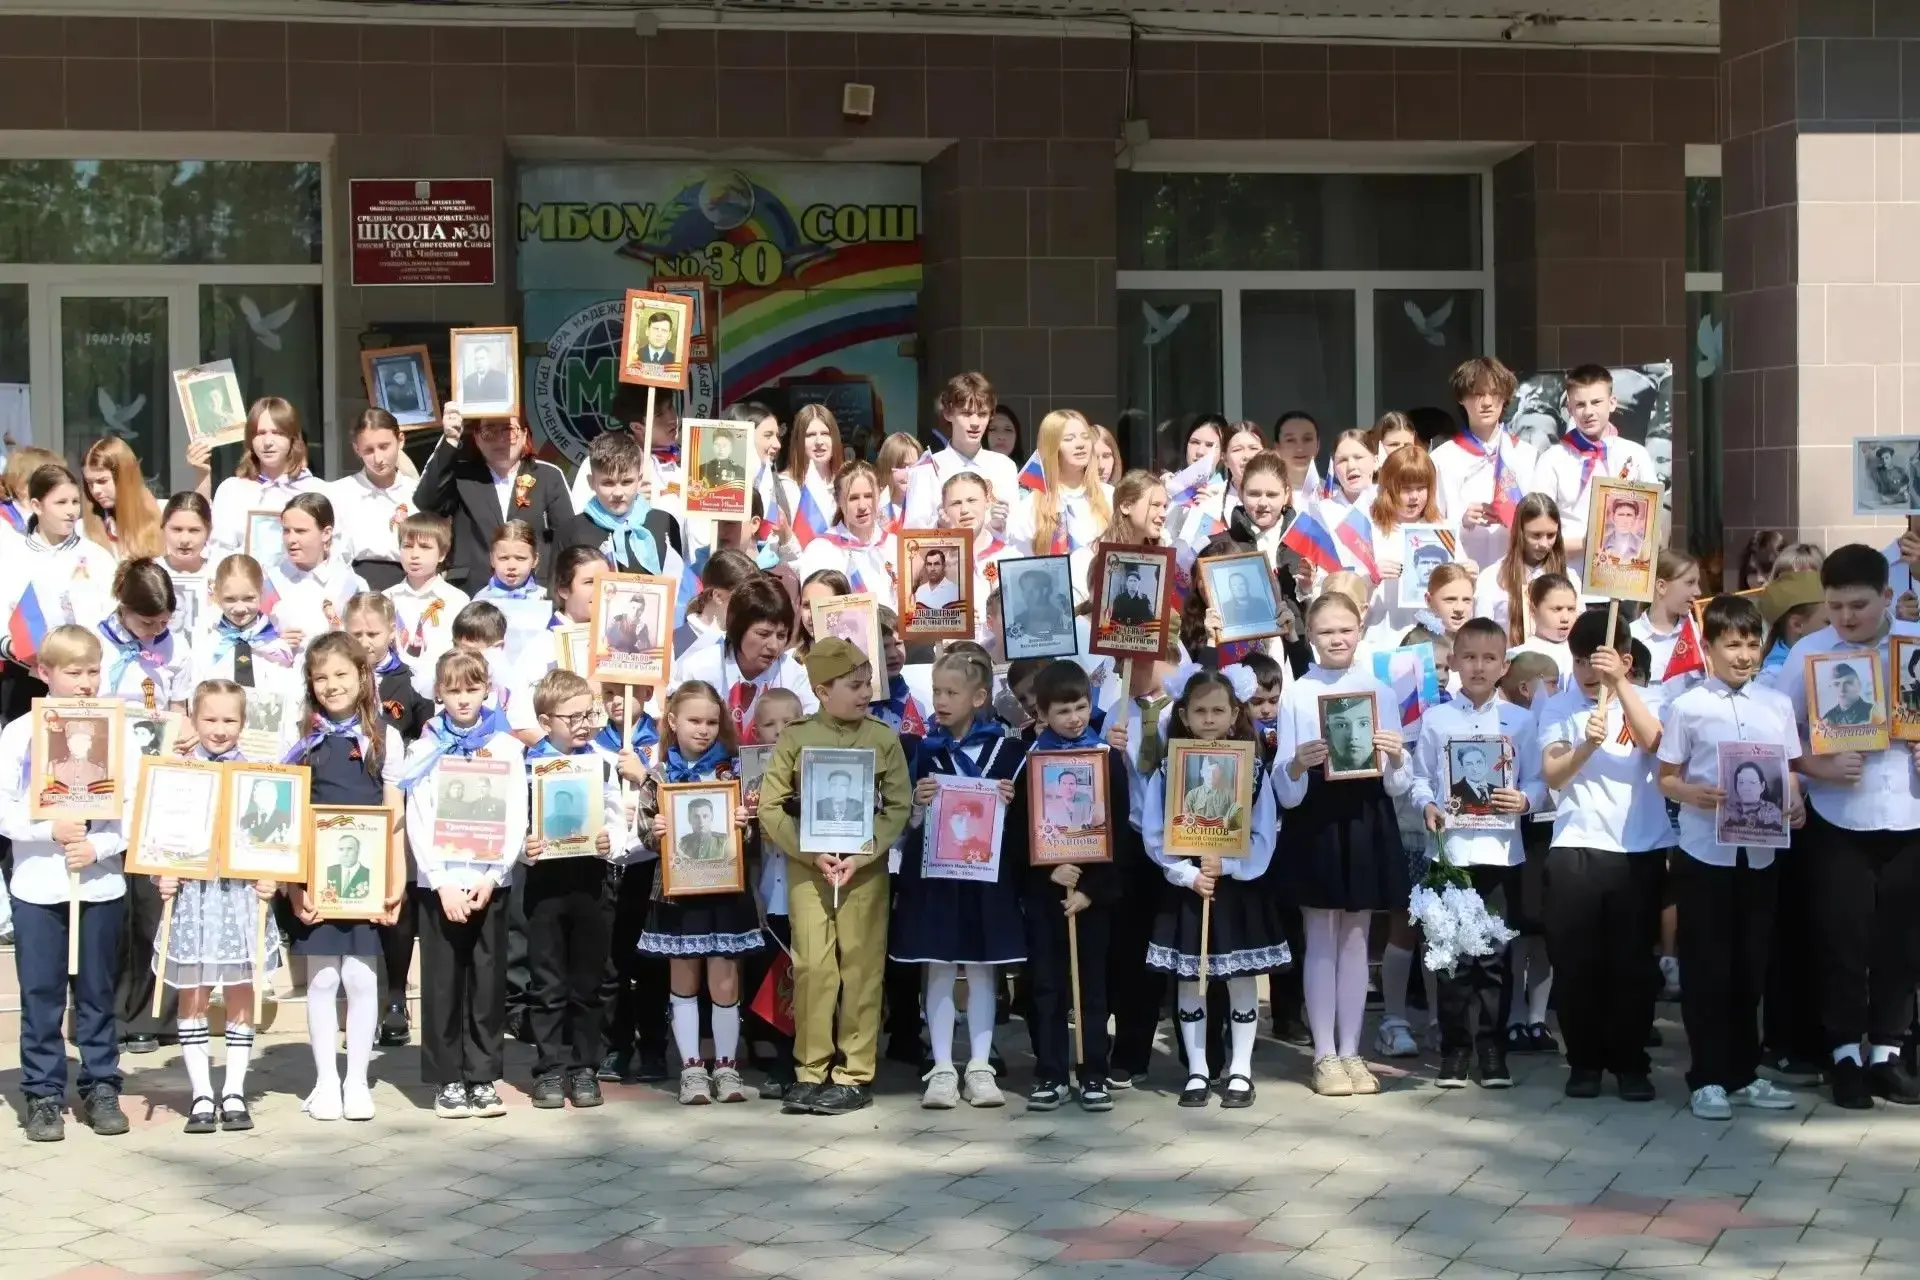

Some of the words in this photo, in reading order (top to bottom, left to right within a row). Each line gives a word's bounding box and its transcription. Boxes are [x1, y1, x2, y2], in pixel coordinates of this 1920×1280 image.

[395, 214, 490, 222] ОБЩЕОБРАЗОВАТЕЛЬНАЯ
[517, 202, 655, 242] МБОУ
[801, 203, 917, 244] СОШ
[357, 223, 446, 240] ШКОЛА
[452, 223, 490, 240] №30
[386, 241, 411, 249] Героя
[412, 240, 462, 248] Советского
[464, 240, 491, 248] Союза
[85, 331, 152, 346] 1941-1945
[547, 330, 571, 360] ВЕРА
[572, 302, 626, 329] НАДЕЖД
[538, 364, 550, 396] ТРУД
[539, 403, 571, 451] УЧЕНИЕ
[1186, 827, 1229, 836] ОСИПОВ
[1046, 837, 1098, 847] Архипова
